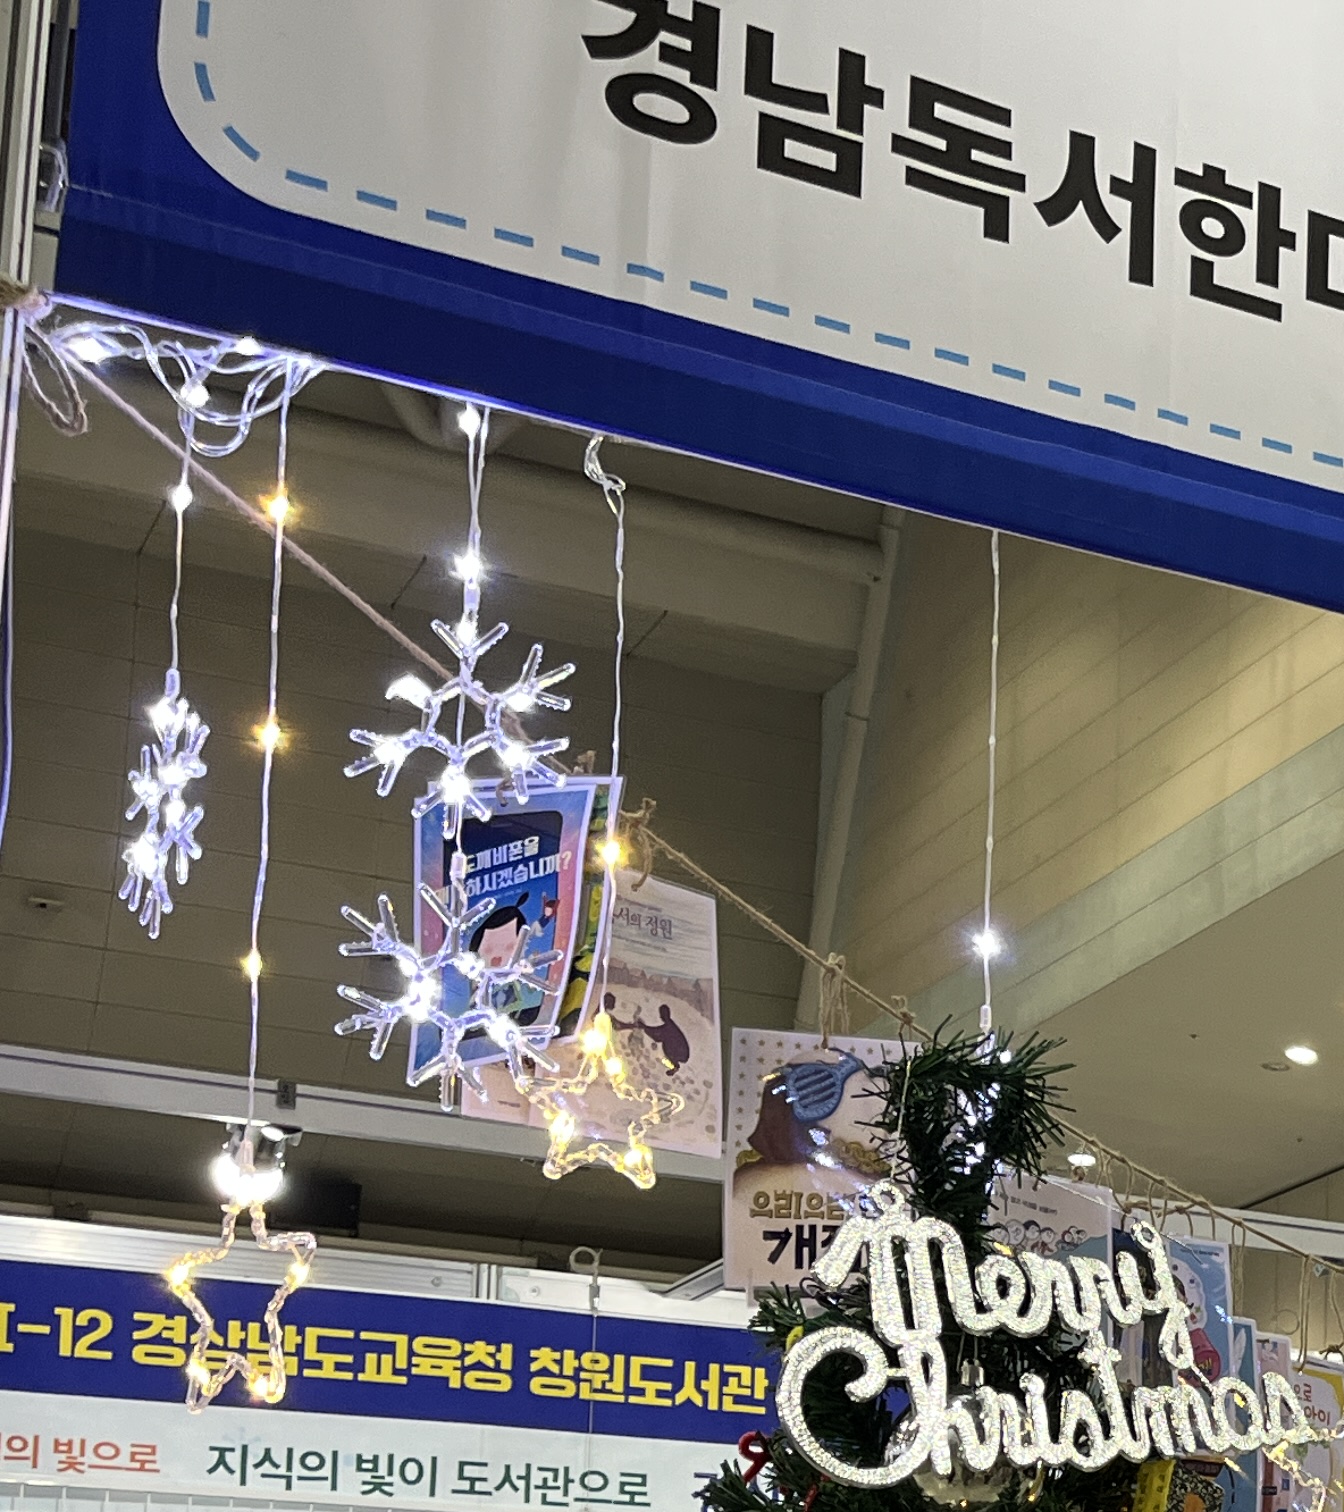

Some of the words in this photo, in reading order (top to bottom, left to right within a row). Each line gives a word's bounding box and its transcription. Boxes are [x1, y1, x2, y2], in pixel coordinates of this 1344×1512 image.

[436, 851, 572, 906] 하시겠습니까?
[811, 1212, 1194, 1369] Merry
[0, 1303, 113, 1361] I-12
[131, 1312, 513, 1393] 경상남도교육청
[529, 1347, 769, 1415] 창원도서관
[776, 1320, 1318, 1488] Christmas
[0, 1432, 40, 1469] 의
[53, 1437, 161, 1474] 빛으로
[206, 1444, 339, 1492] 지식의
[355, 1452, 438, 1497] 빛이
[451, 1460, 652, 1507] 도서관으로
